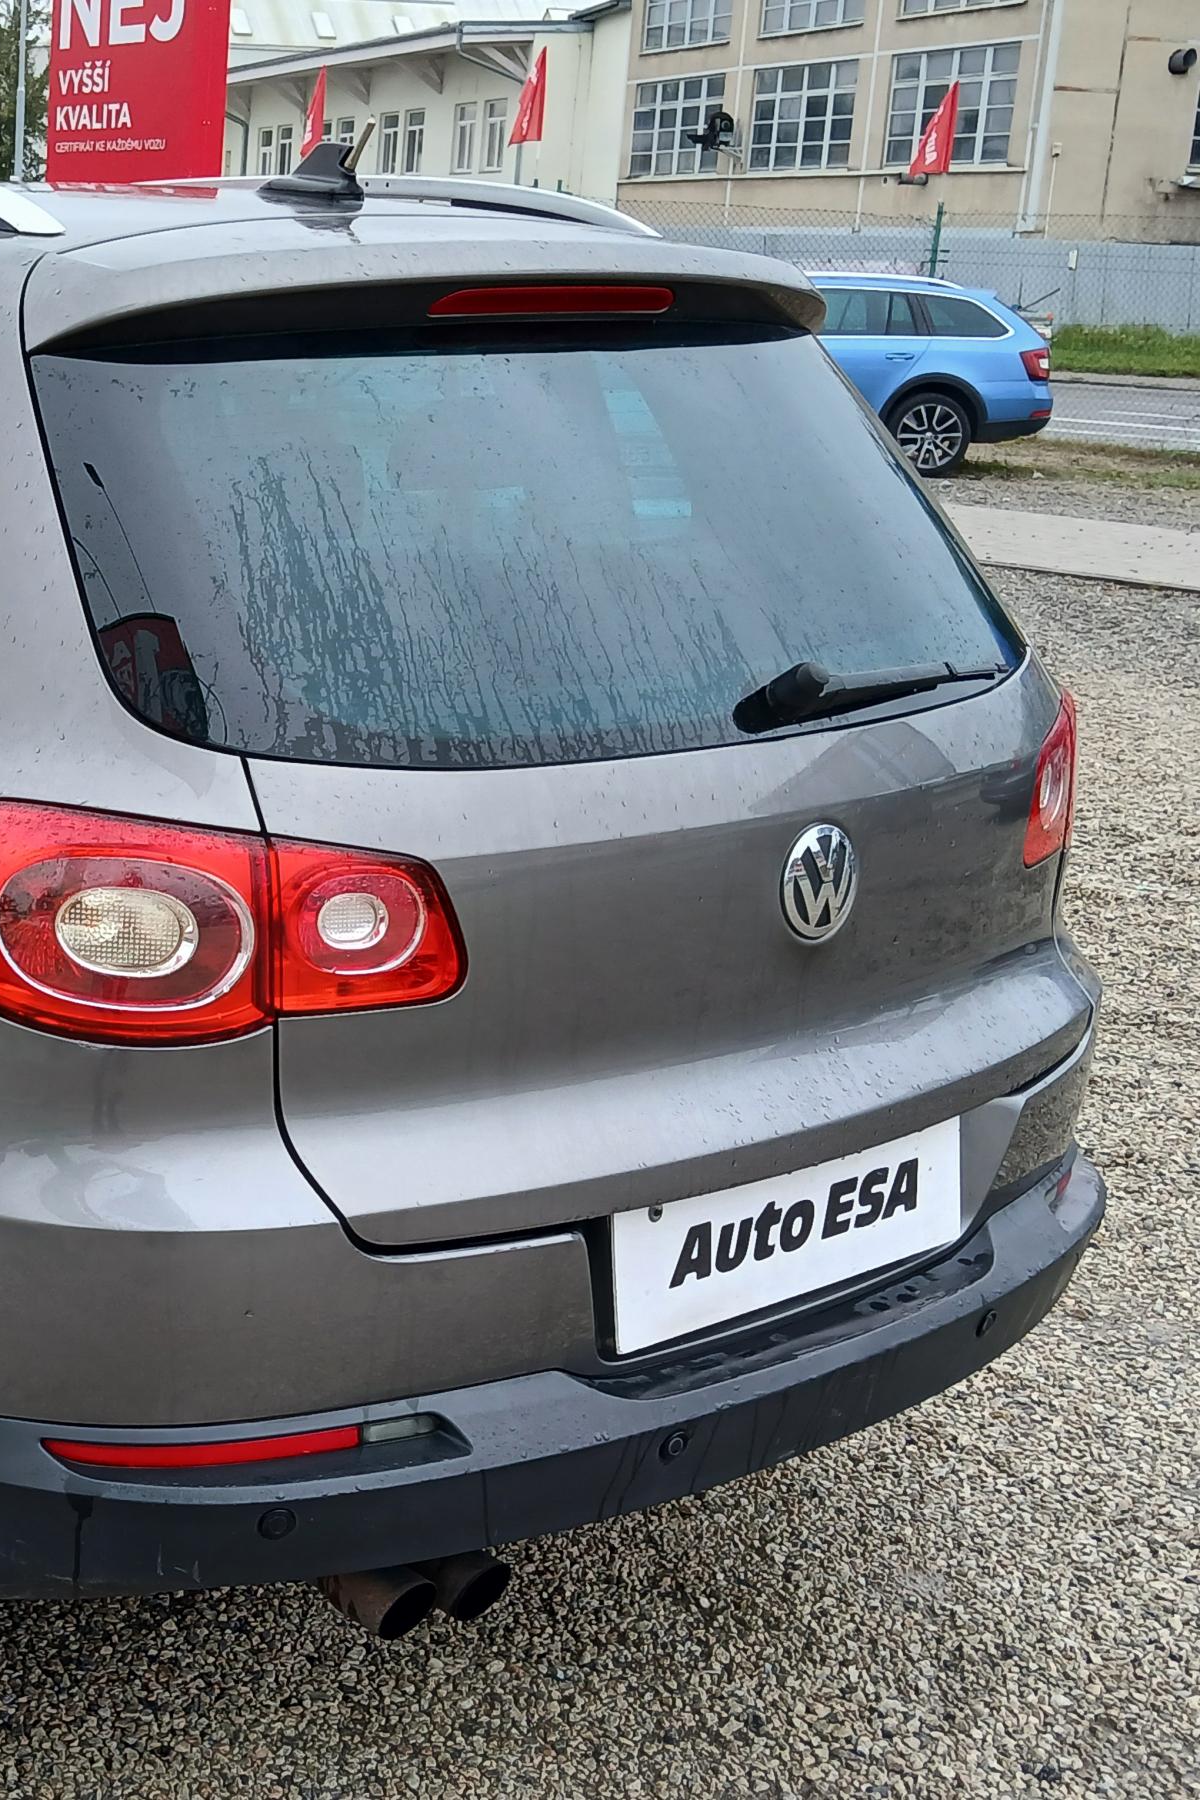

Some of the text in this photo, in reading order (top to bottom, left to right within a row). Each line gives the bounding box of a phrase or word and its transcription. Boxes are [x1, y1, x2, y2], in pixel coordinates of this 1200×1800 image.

[58, 0, 186, 50] NEJ
[58, 59, 112, 96] VYŠŠÍ
[55, 102, 132, 131] KVALITA
[55, 138, 166, 153] CERTIFIKÁT KE KAŽDÉMU VOZU
[668, 1157, 919, 1289] Auto ESA
